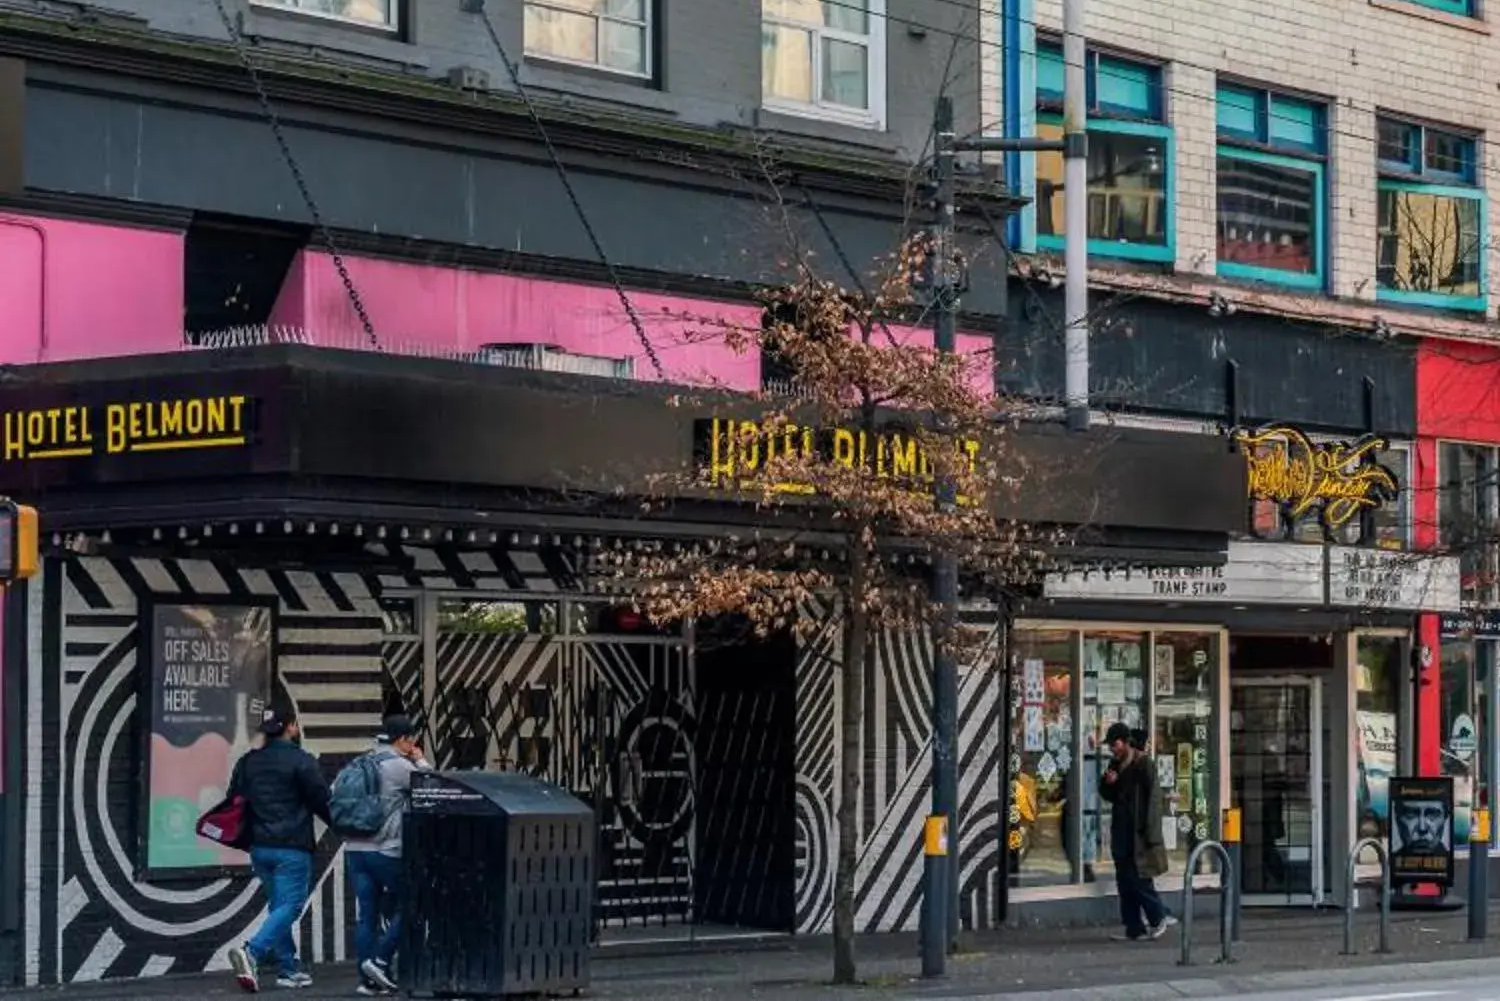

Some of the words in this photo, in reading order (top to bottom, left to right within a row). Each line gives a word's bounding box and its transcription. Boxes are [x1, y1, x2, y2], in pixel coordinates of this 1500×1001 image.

[4, 405, 93, 460] HOTEL
[107, 396, 246, 454] BELMONT
[1152, 580, 1187, 595] TRAMP
[1191, 581, 1228, 596] STAMP
[164, 640, 189, 662] OFF
[191, 640, 230, 662] SALES
[163, 664, 230, 687] AVAILABLE
